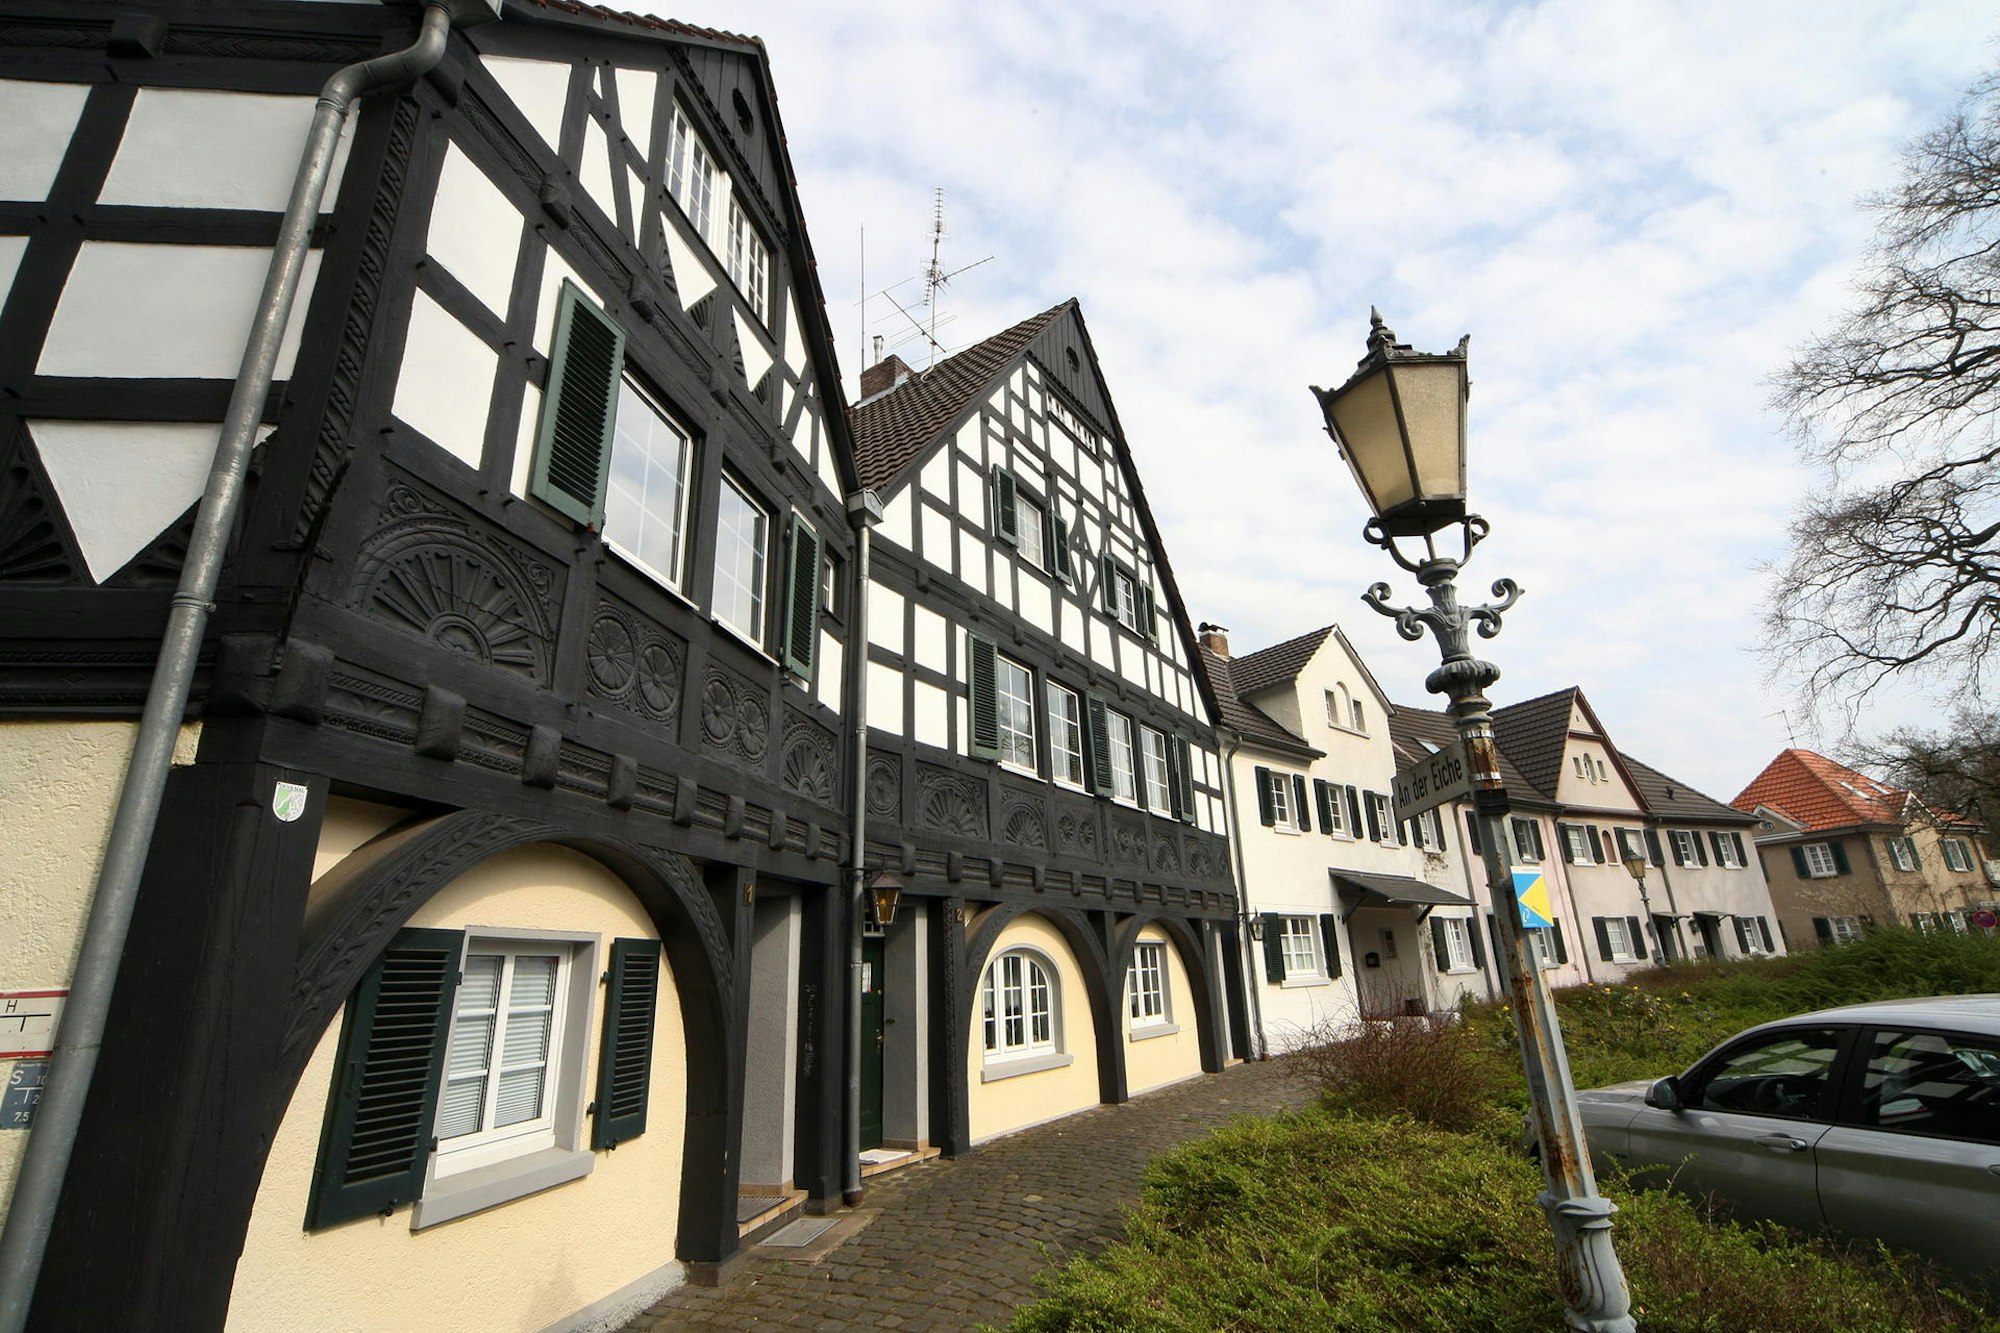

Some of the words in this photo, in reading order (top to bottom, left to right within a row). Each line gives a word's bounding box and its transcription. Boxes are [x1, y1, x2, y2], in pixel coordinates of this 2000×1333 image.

[1398, 781, 1411, 808] An
[1412, 773, 1428, 800] der
[1430, 756, 1463, 791] Eiche
[6, 999, 18, 1013] H
[10, 1070, 25, 1085] S
